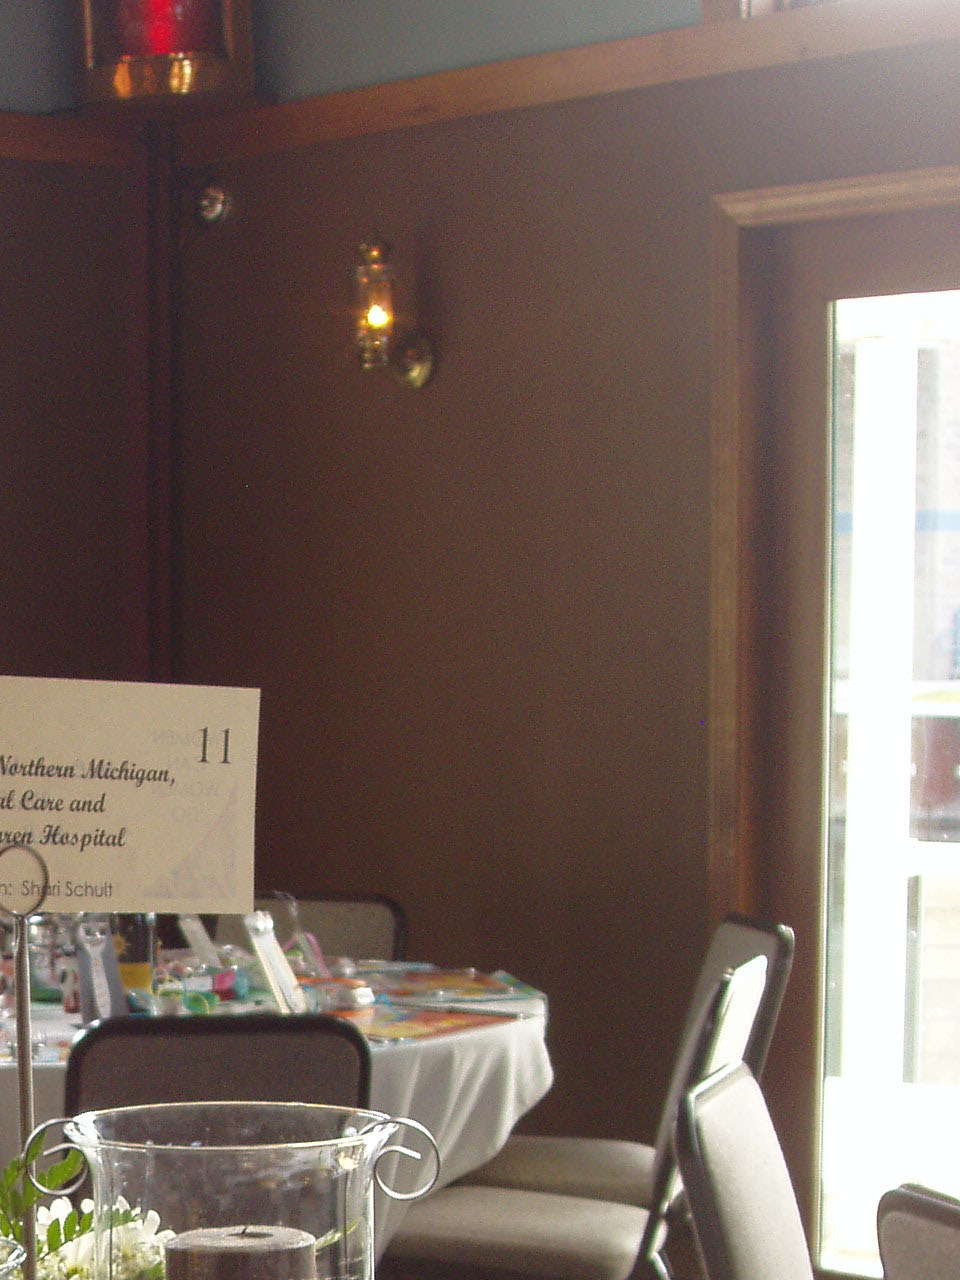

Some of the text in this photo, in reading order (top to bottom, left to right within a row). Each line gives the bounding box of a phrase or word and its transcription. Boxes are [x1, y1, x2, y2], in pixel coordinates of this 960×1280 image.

[197, 727, 231, 764] 11
[81, 758, 176, 788] Michigan,
[21, 789, 64, 812] Care
[69, 793, 106, 814] and
[40, 824, 126, 852] Hospital
